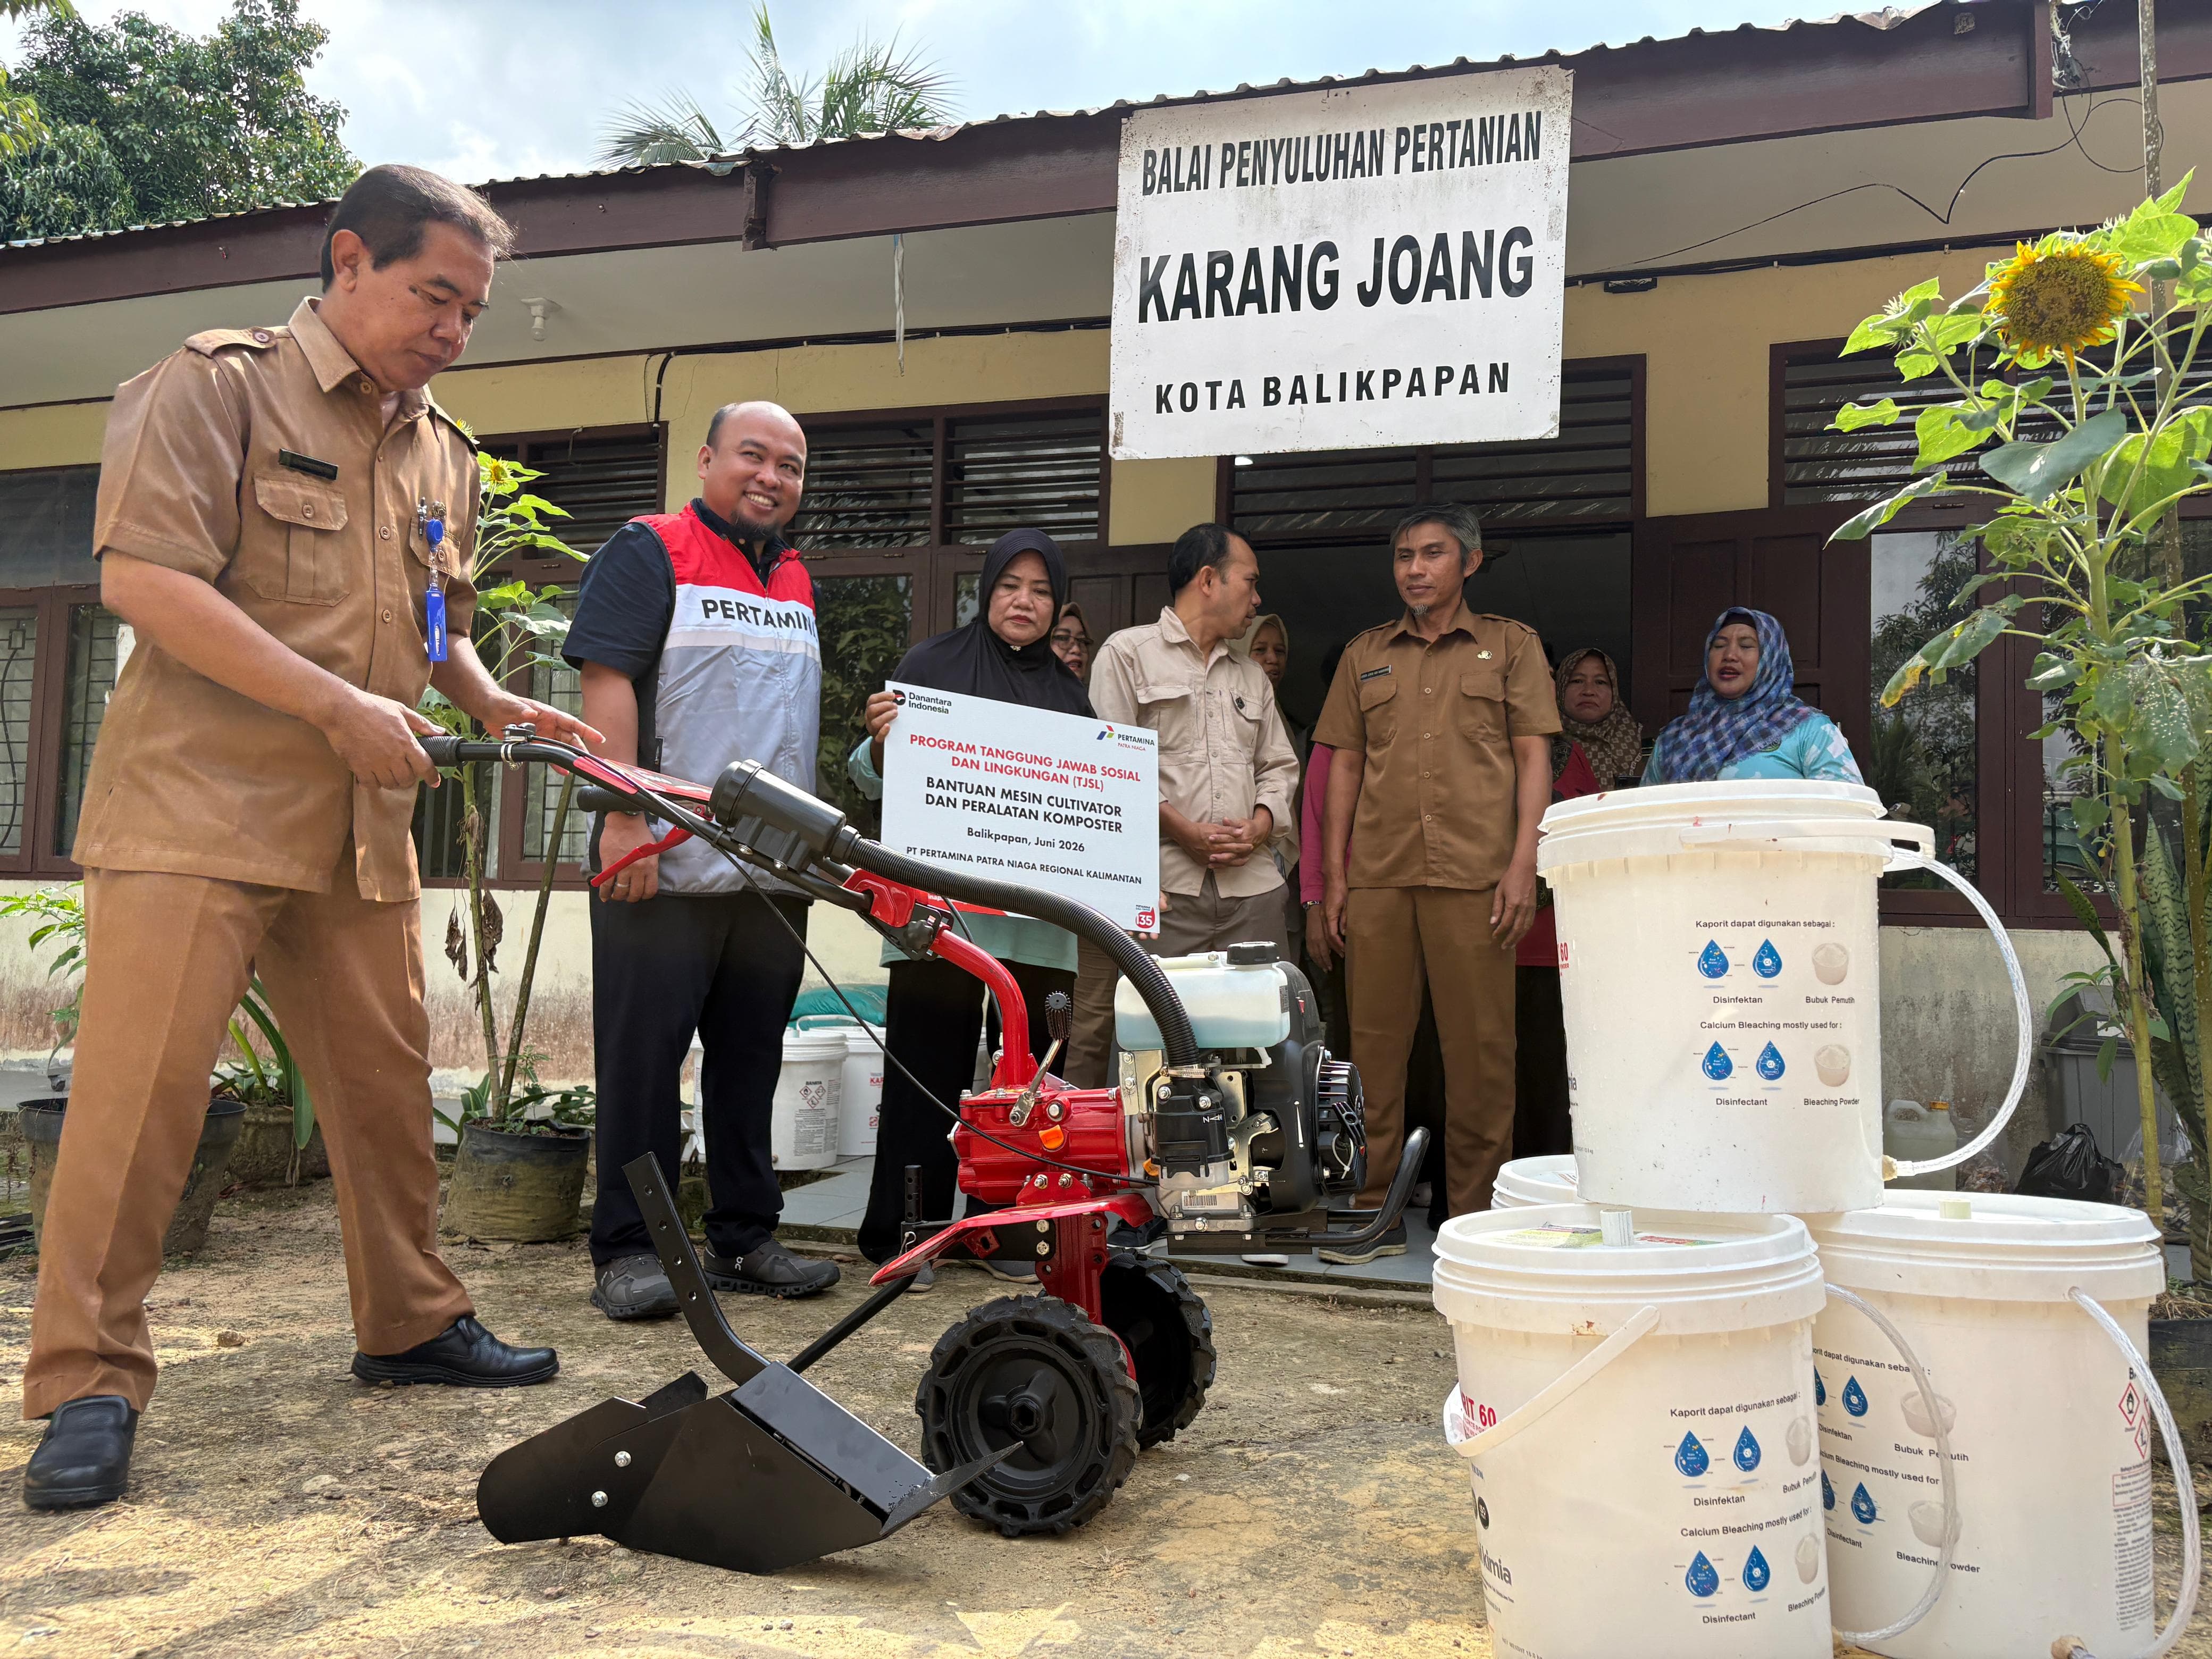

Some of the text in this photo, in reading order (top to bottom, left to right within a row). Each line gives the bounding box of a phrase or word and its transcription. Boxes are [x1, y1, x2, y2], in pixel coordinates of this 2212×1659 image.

[1142, 111, 1542, 196] BALAI PENYULUHAN PERTANIAN
[1138, 226, 1535, 324] KARANG JOANG
[1155, 363, 1510, 414] KOTA BALIKPAPAN
[909, 692, 952, 707] Danantara
[909, 700, 949, 714] Indonesia
[1118, 734, 1155, 746] PERTAMINA
[910, 734, 1141, 782] PROGRAM TANGGUNG JAWAB SOSIAL
[951, 756, 1104, 792] DAN LINGKUNGAN (TJSL)
[926, 776, 1122, 817] BANTUAN MESIN CULTIVATOR
[925, 793, 1122, 833] DAN PERALATAN KOMPOSTER
[967, 827, 1085, 852] Balikpapan, Juni 2026
[907, 846, 1142, 884] PT PERTAMINA PATRA NIAGA REGIONAL KALIMANTAN
[1758, 919, 1801, 928] digunakan
[1560, 942, 1569, 961] 60
[1824, 1351, 1842, 1360] dapat
[1844, 1354, 1885, 1369] digunakan
[1670, 1408, 1706, 1418] Kaporit
[1708, 1405, 1733, 1416] dapat
[1736, 1399, 1774, 1413] digunakan
[1776, 1392, 1797, 1405] sebagai
[1479, 1404, 1496, 1427] 60
[1818, 1423, 1852, 1441] Disinfektan
[1895, 1443, 1969, 1461] Bubuk Peutih
[1836, 1455, 1870, 1473] Bleaching
[1872, 1467, 1899, 1479] mostly
[1901, 1473, 1923, 1482] used
[1926, 1476, 1940, 1485] for
[1783, 1480, 1801, 1494] Bubuk
[1694, 1495, 1745, 1506] Disinfektan
[1680, 1527, 1720, 1537] Calcium
[1722, 1522, 1764, 1535] Bleaching
[1765, 1516, 1788, 1529] mostly
[1789, 1510, 1803, 1522] used
[1827, 1528, 1862, 1548] Disinfectant
[1950, 1563, 1980, 1573] owder
[1788, 1597, 1814, 1612] Bleaching
[1703, 1612, 1756, 1623] Disinfectant
